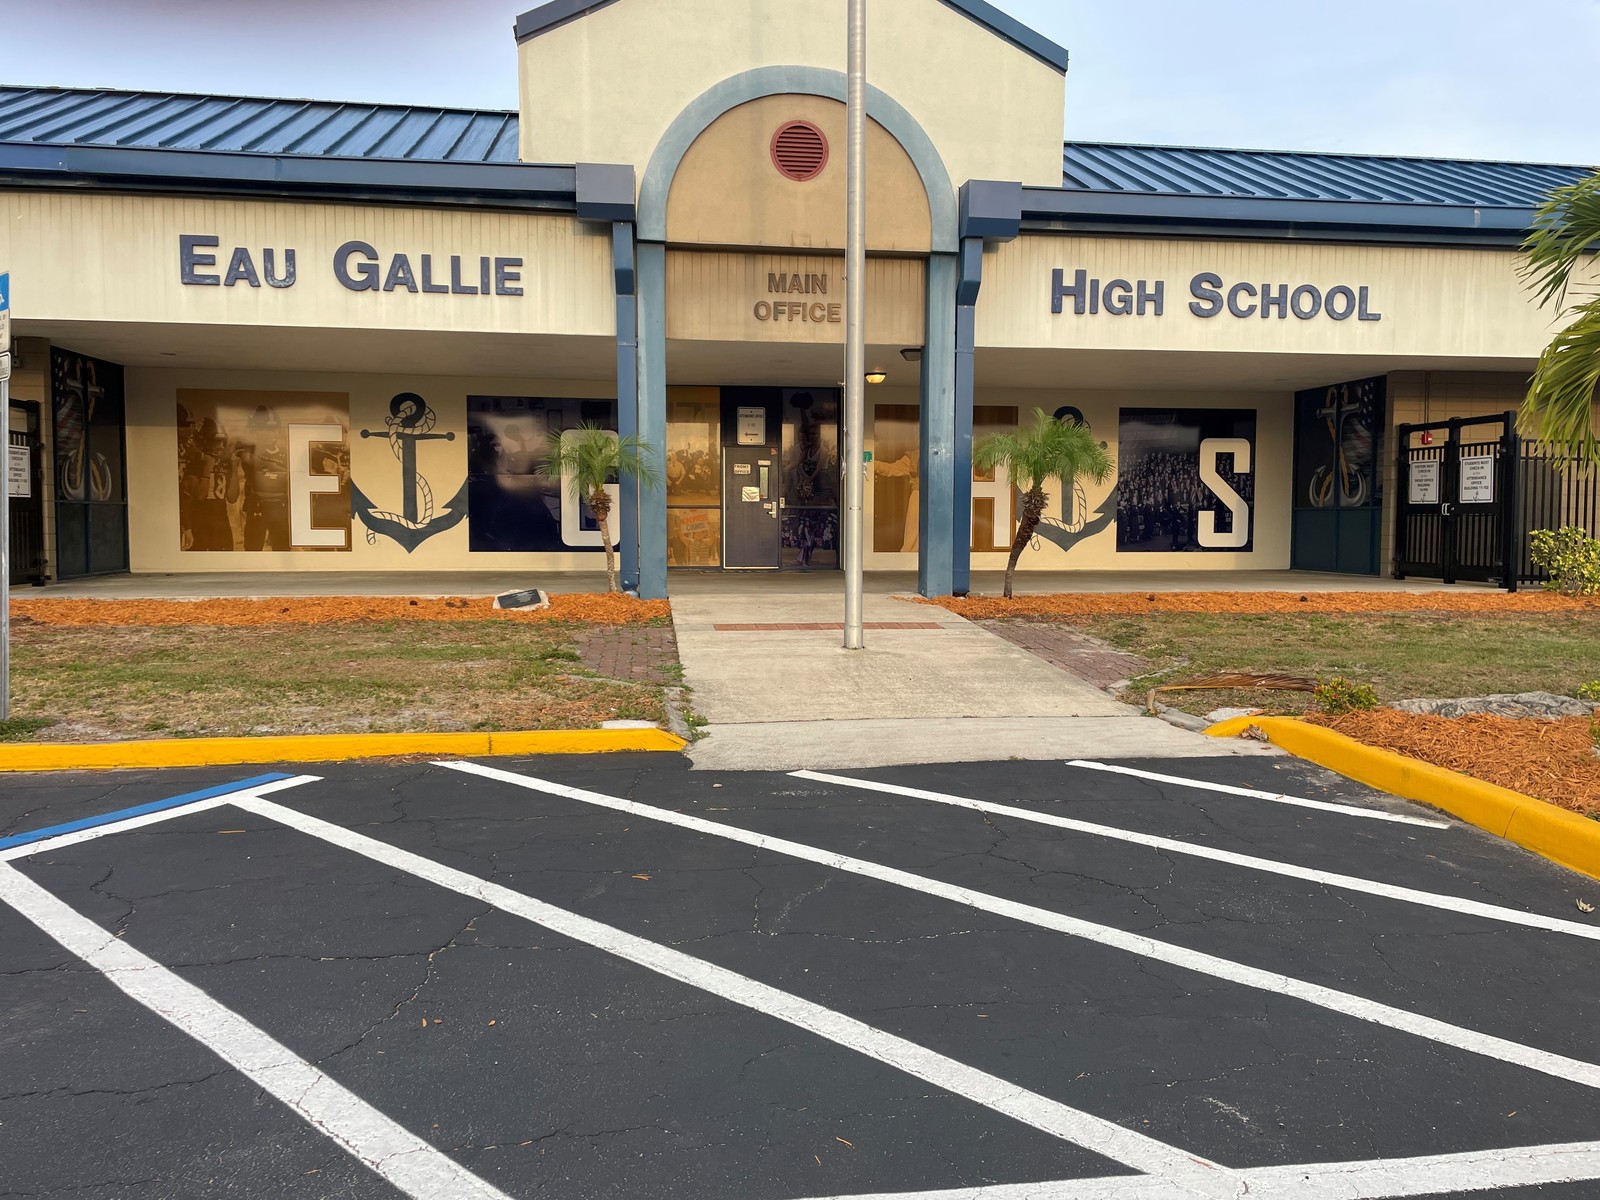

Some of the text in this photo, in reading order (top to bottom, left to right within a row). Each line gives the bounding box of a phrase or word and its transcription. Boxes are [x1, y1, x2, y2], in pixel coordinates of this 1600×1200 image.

[179, 234, 524, 296] EAU GALLIE
[768, 272, 827, 294] MAIN
[754, 300, 842, 322] OFFICE
[1051, 268, 1382, 320] HIGH SCHOOL
[289, 424, 346, 546] E
[1198, 438, 1250, 548] S
